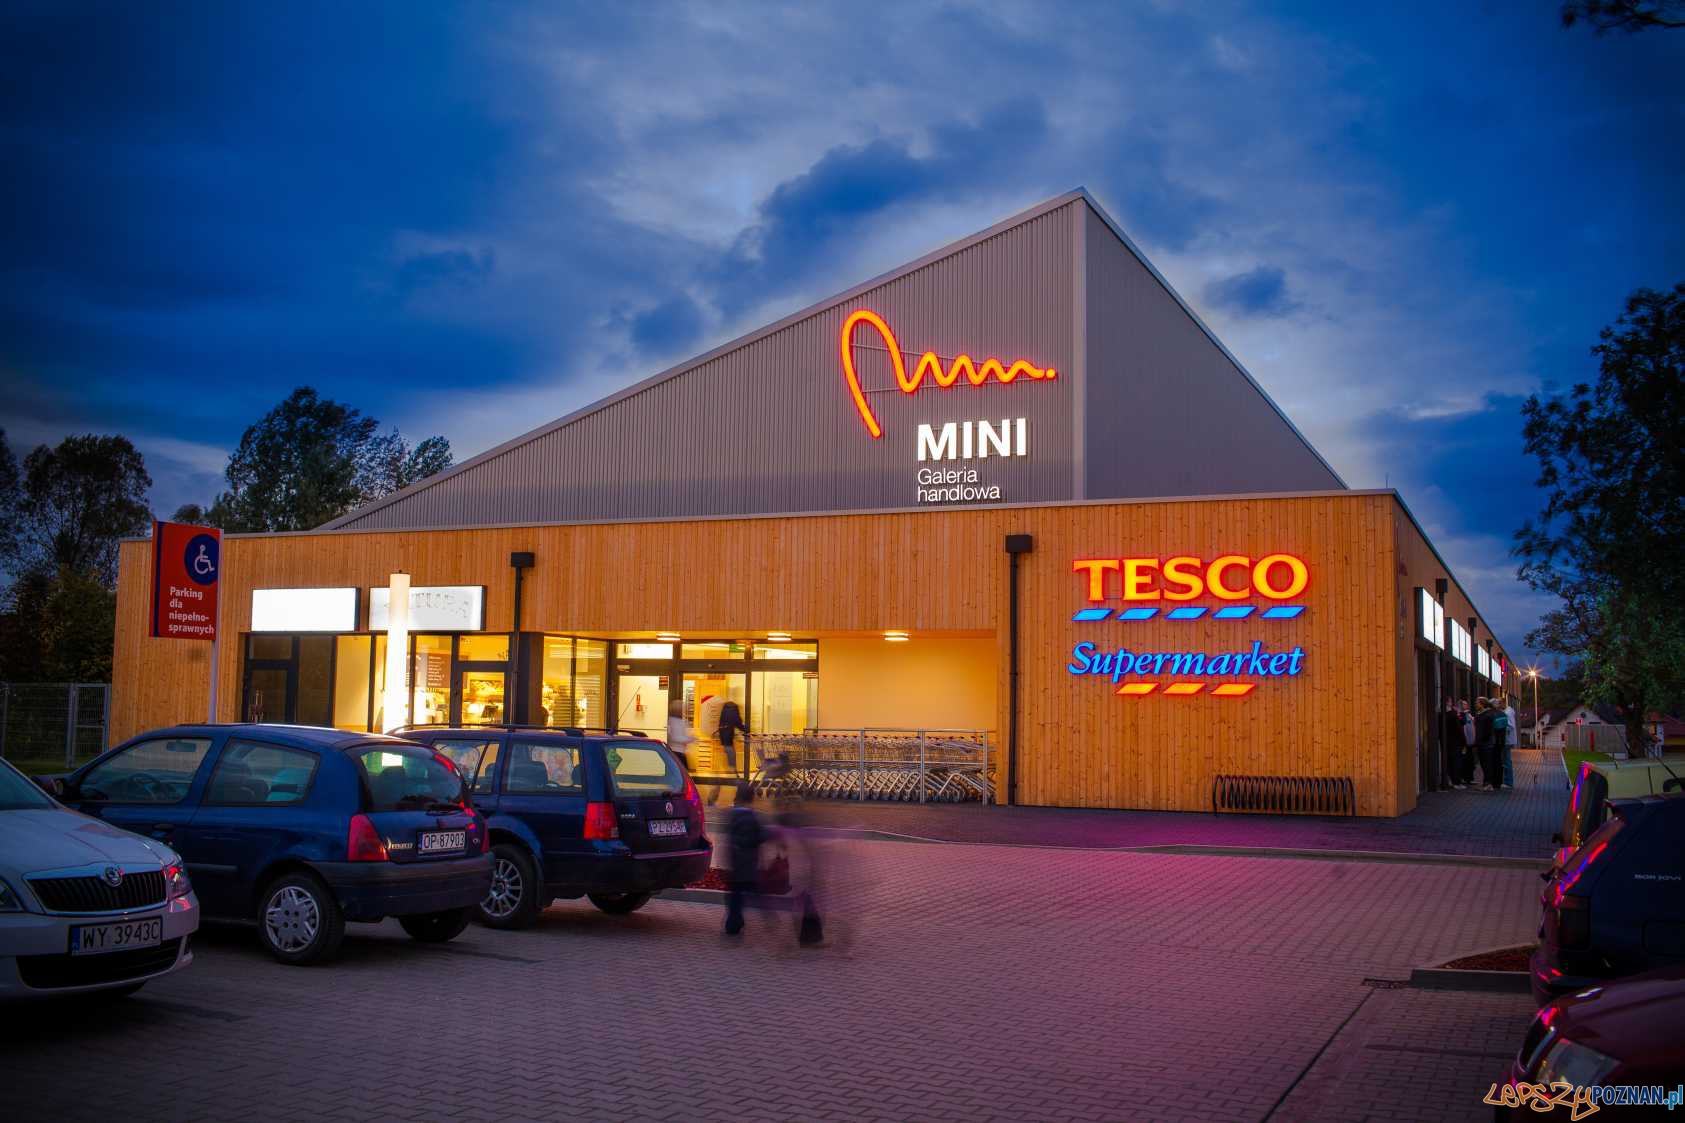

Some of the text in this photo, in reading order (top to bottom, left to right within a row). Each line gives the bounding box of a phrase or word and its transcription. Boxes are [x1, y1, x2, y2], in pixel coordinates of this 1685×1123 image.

[918, 418, 1026, 461] MINI
[917, 466, 978, 485] Galeria
[917, 484, 1001, 502] handlowa
[1072, 553, 1309, 601] TESCO
[169, 586, 203, 600] Parking
[169, 599, 183, 609] dla
[168, 623, 215, 635] sprawnych
[1068, 640, 1305, 684] Supermarket
[83, 926, 108, 949] WY
